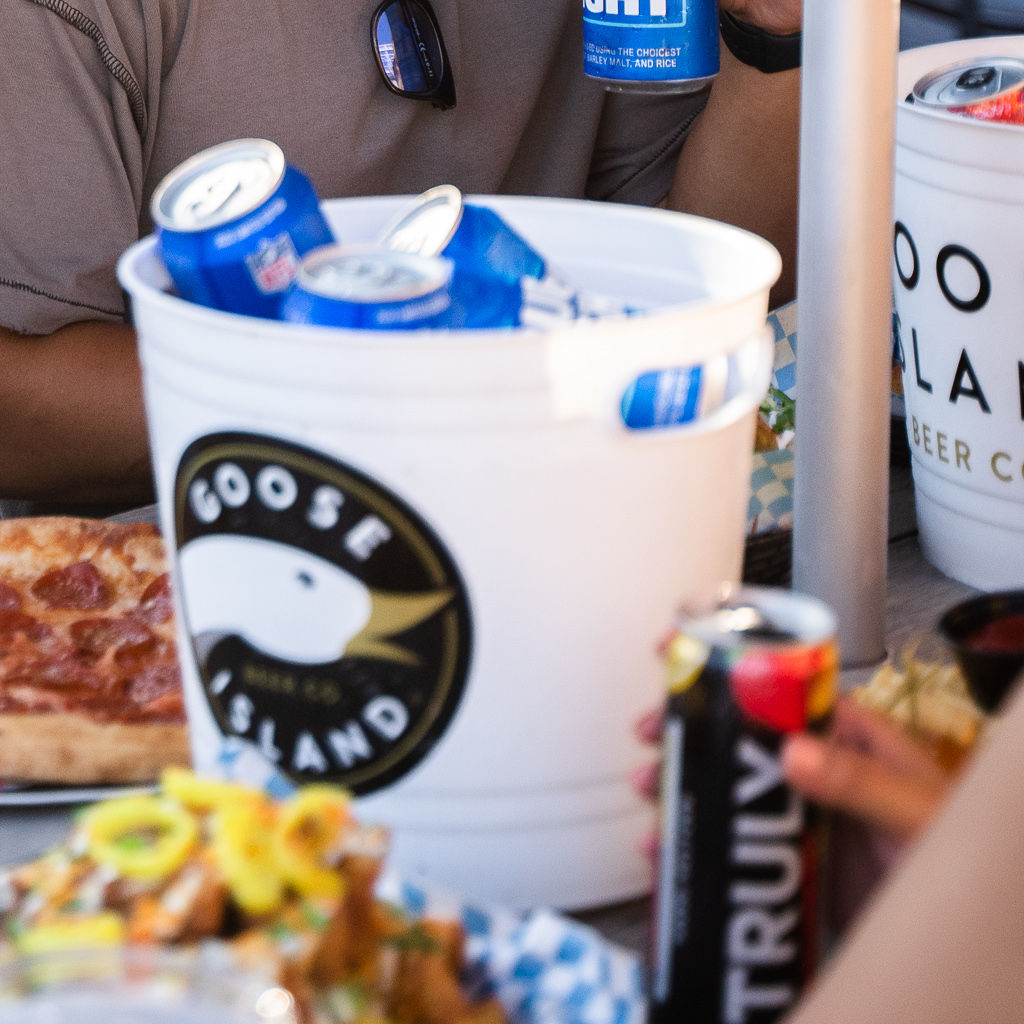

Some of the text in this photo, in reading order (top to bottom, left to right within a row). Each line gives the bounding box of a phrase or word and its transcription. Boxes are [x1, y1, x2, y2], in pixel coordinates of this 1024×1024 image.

[618, 47, 634, 57] THE
[636, 47, 682, 58] CHOICEST
[634, 59, 654, 68] AND
[656, 59, 677, 68] RICE
[897, 312, 1024, 422] LA
[911, 414, 1024, 483] BEER C
[188, 462, 393, 561] GOOSE
[208, 669, 410, 773] ISLAND
[721, 736, 806, 1024] TRULY
